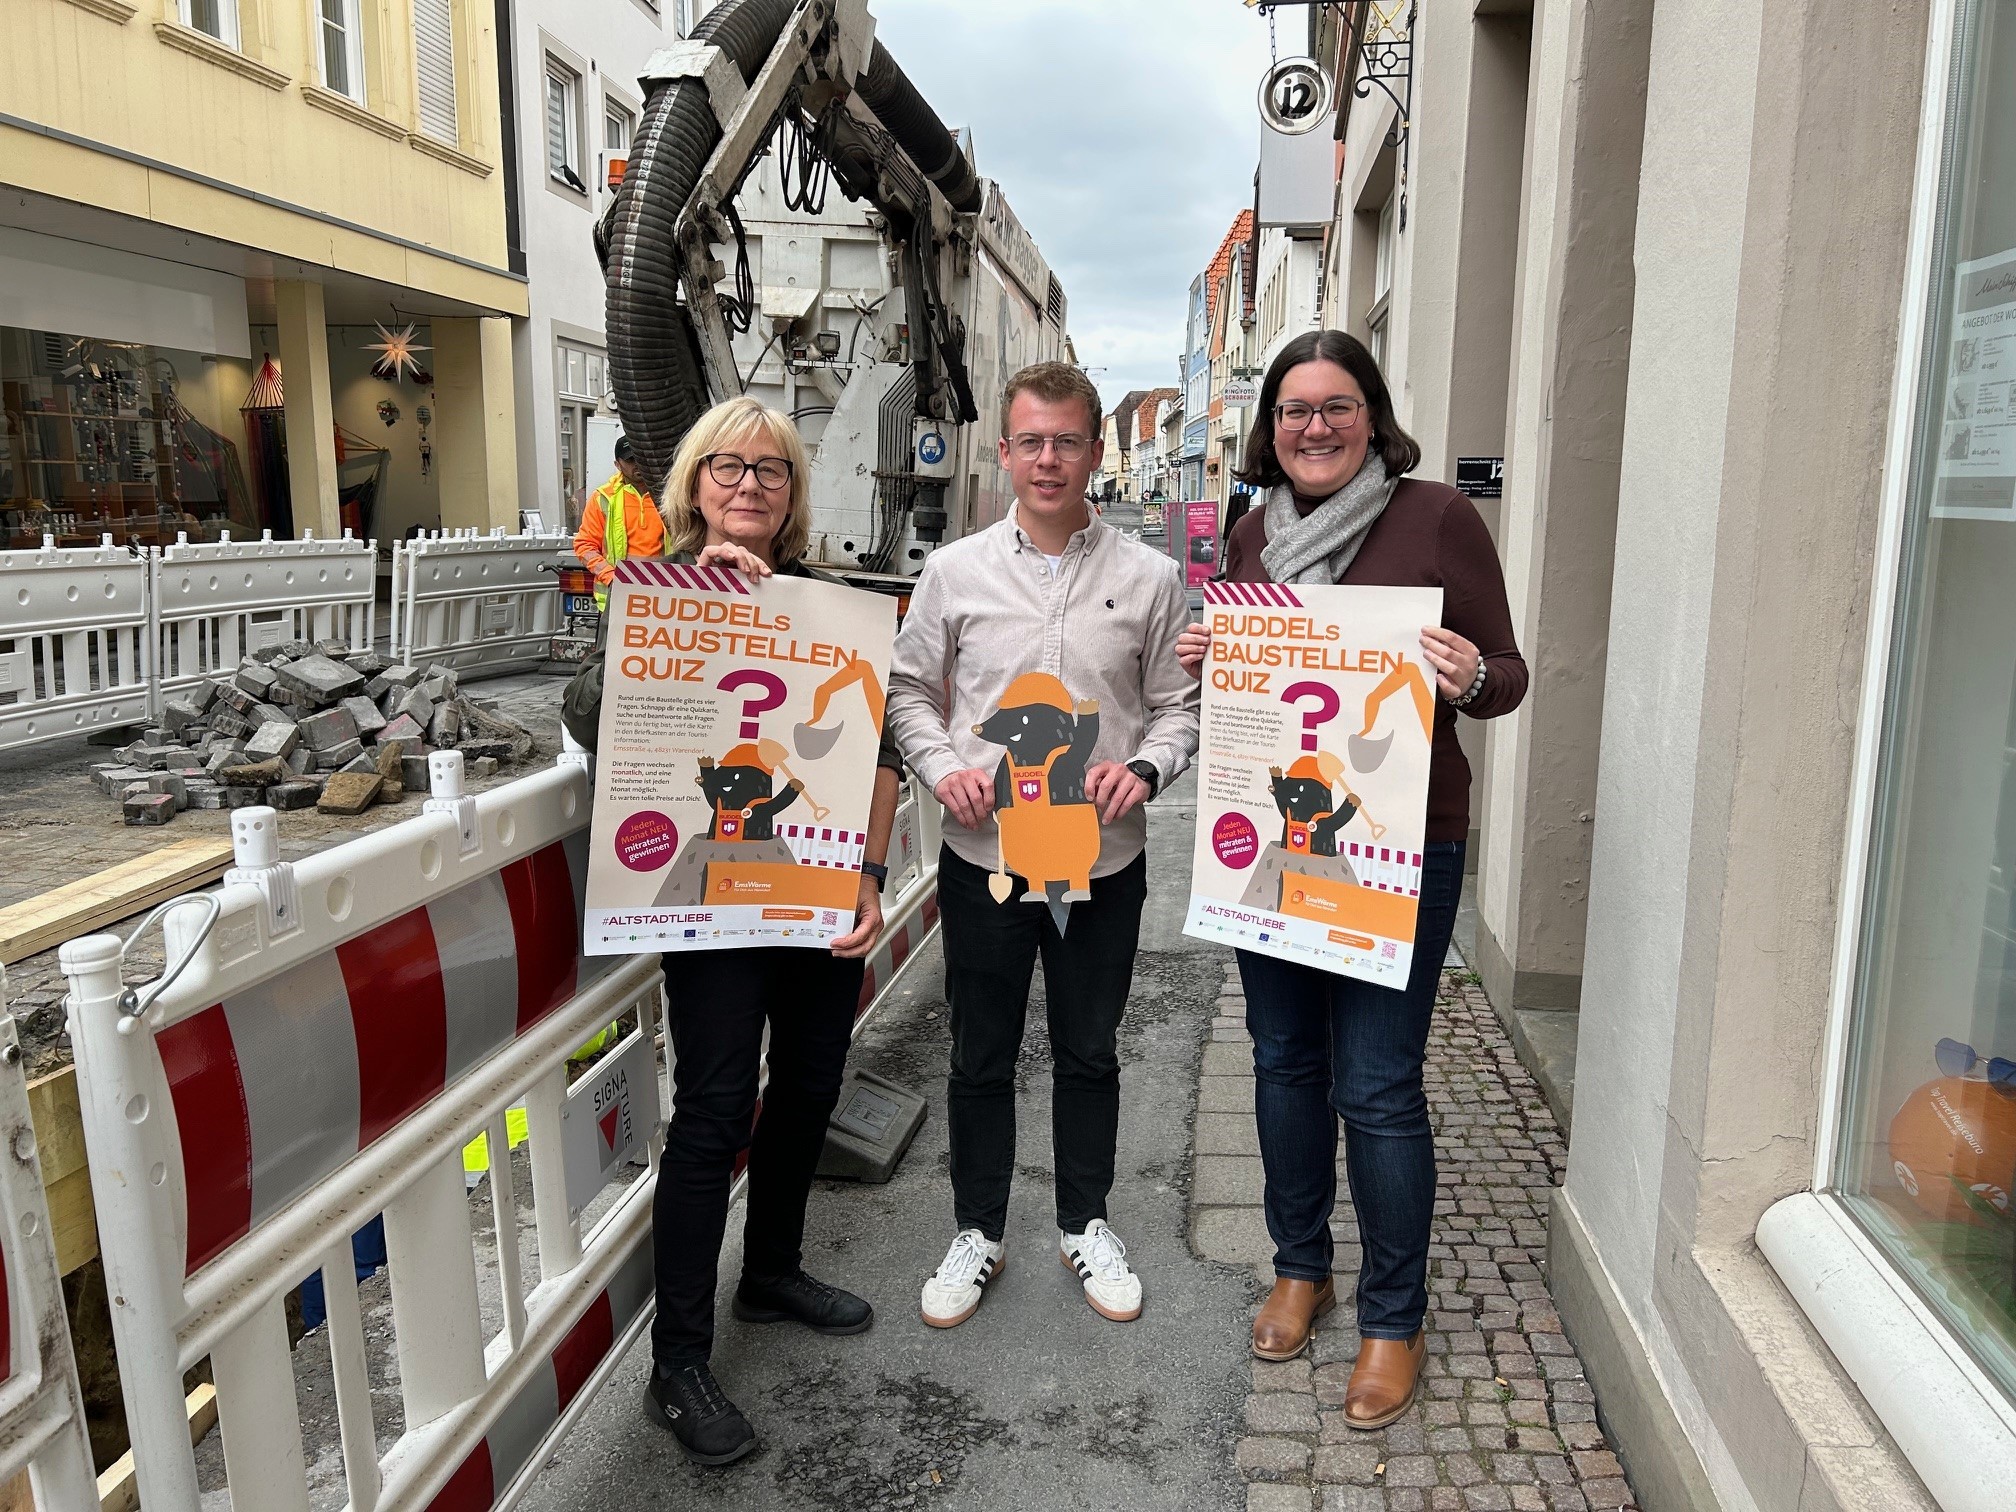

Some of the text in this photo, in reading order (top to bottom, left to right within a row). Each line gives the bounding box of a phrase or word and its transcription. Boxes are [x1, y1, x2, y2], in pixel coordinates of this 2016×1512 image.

[1280, 78, 1310, 117] j2
[574, 598, 590, 612] OB
[623, 624, 858, 670] BAUSTELLEN
[621, 655, 706, 682] QUIZ
[1213, 642, 1403, 675] BAUSTELLEN
[1212, 669, 1271, 694] QUIZ
[621, 823, 668, 845] Monat NEU
[630, 819, 655, 833] Jeden
[1216, 826, 1250, 840] Monat NEU
[1223, 821, 1240, 830] Jeden
[624, 837, 661, 854] mitraten
[629, 843, 670, 863] gewinnen
[1219, 837, 1245, 850] mitraten
[1222, 845, 1252, 858] gewinnen
[602, 913, 713, 926] #ALTSTADTLIEBE
[1201, 905, 1286, 931] #ALTSTADTLIEBE
[1937, 1096, 1954, 1116] Travel
